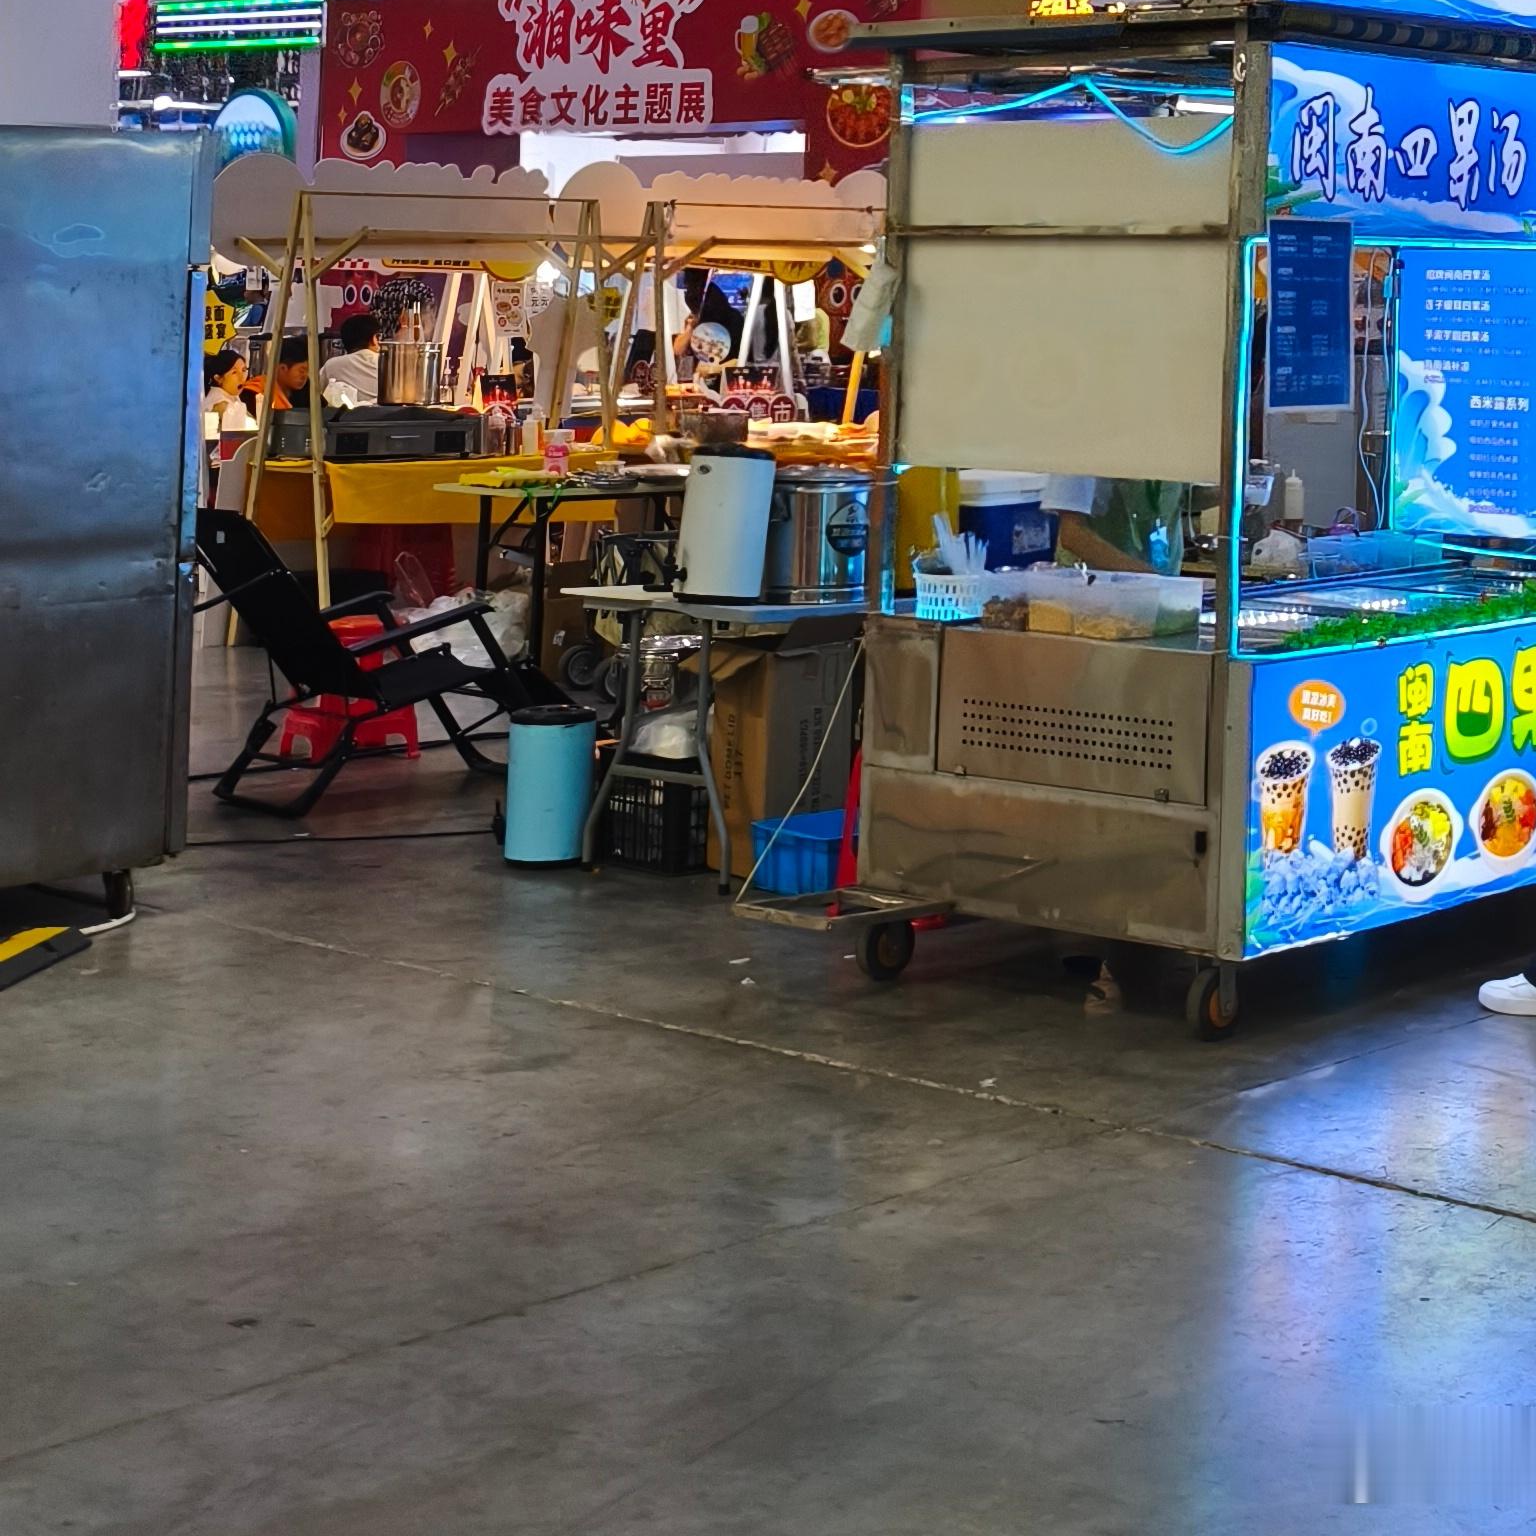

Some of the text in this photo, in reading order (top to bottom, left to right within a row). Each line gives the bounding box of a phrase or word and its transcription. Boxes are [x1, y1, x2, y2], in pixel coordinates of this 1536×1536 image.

[489, 81, 707, 127] 美食文化主题展
[1291, 84, 1528, 211] 闽南四果汤
[1398, 663, 1435, 777] 闽南
